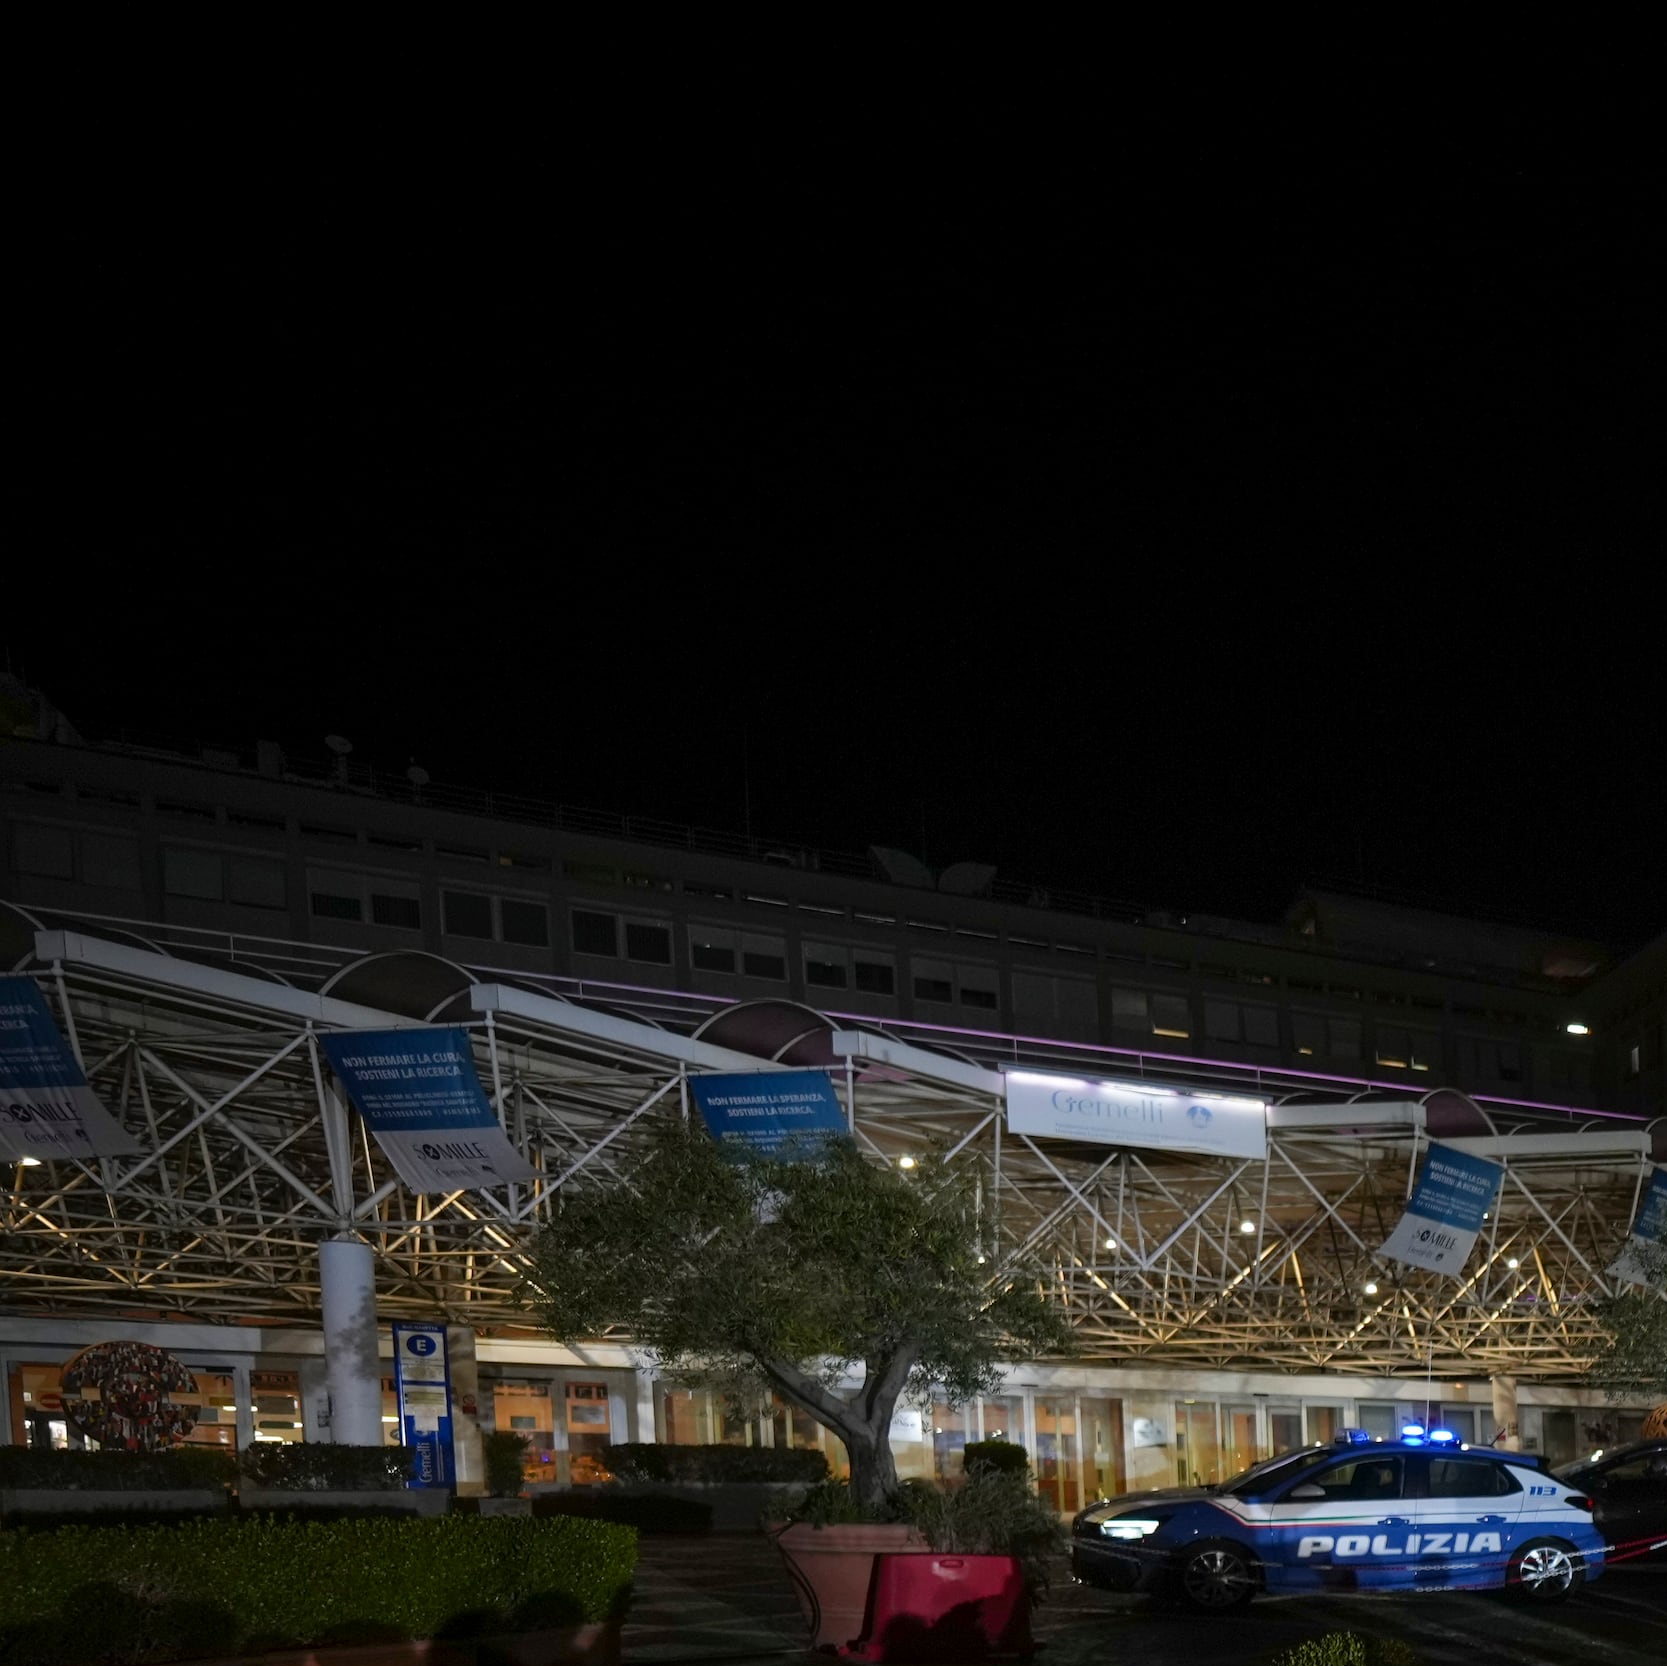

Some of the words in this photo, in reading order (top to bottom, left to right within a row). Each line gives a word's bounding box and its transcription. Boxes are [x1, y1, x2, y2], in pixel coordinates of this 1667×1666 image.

[341, 1056, 368, 1068] NON
[367, 1053, 416, 1067] FERMARE
[417, 1052, 432, 1064] LA
[355, 1070, 401, 1081] SOSTIENI
[401, 1068, 417, 1079] LA
[706, 1096, 729, 1106] NON
[729, 1095, 769, 1105] FERMARE
[768, 1094, 780, 1103] LA
[1051, 1088, 1165, 1124] Gemelli
[727, 1107, 765, 1117] SOSTIENI
[765, 1106, 779, 1115] LA
[416, 1339, 428, 1352] E
[416, 1442, 433, 1484] Gemelli
[1529, 1485, 1558, 1497] 113
[1297, 1531, 1502, 1558] POLIZIA
